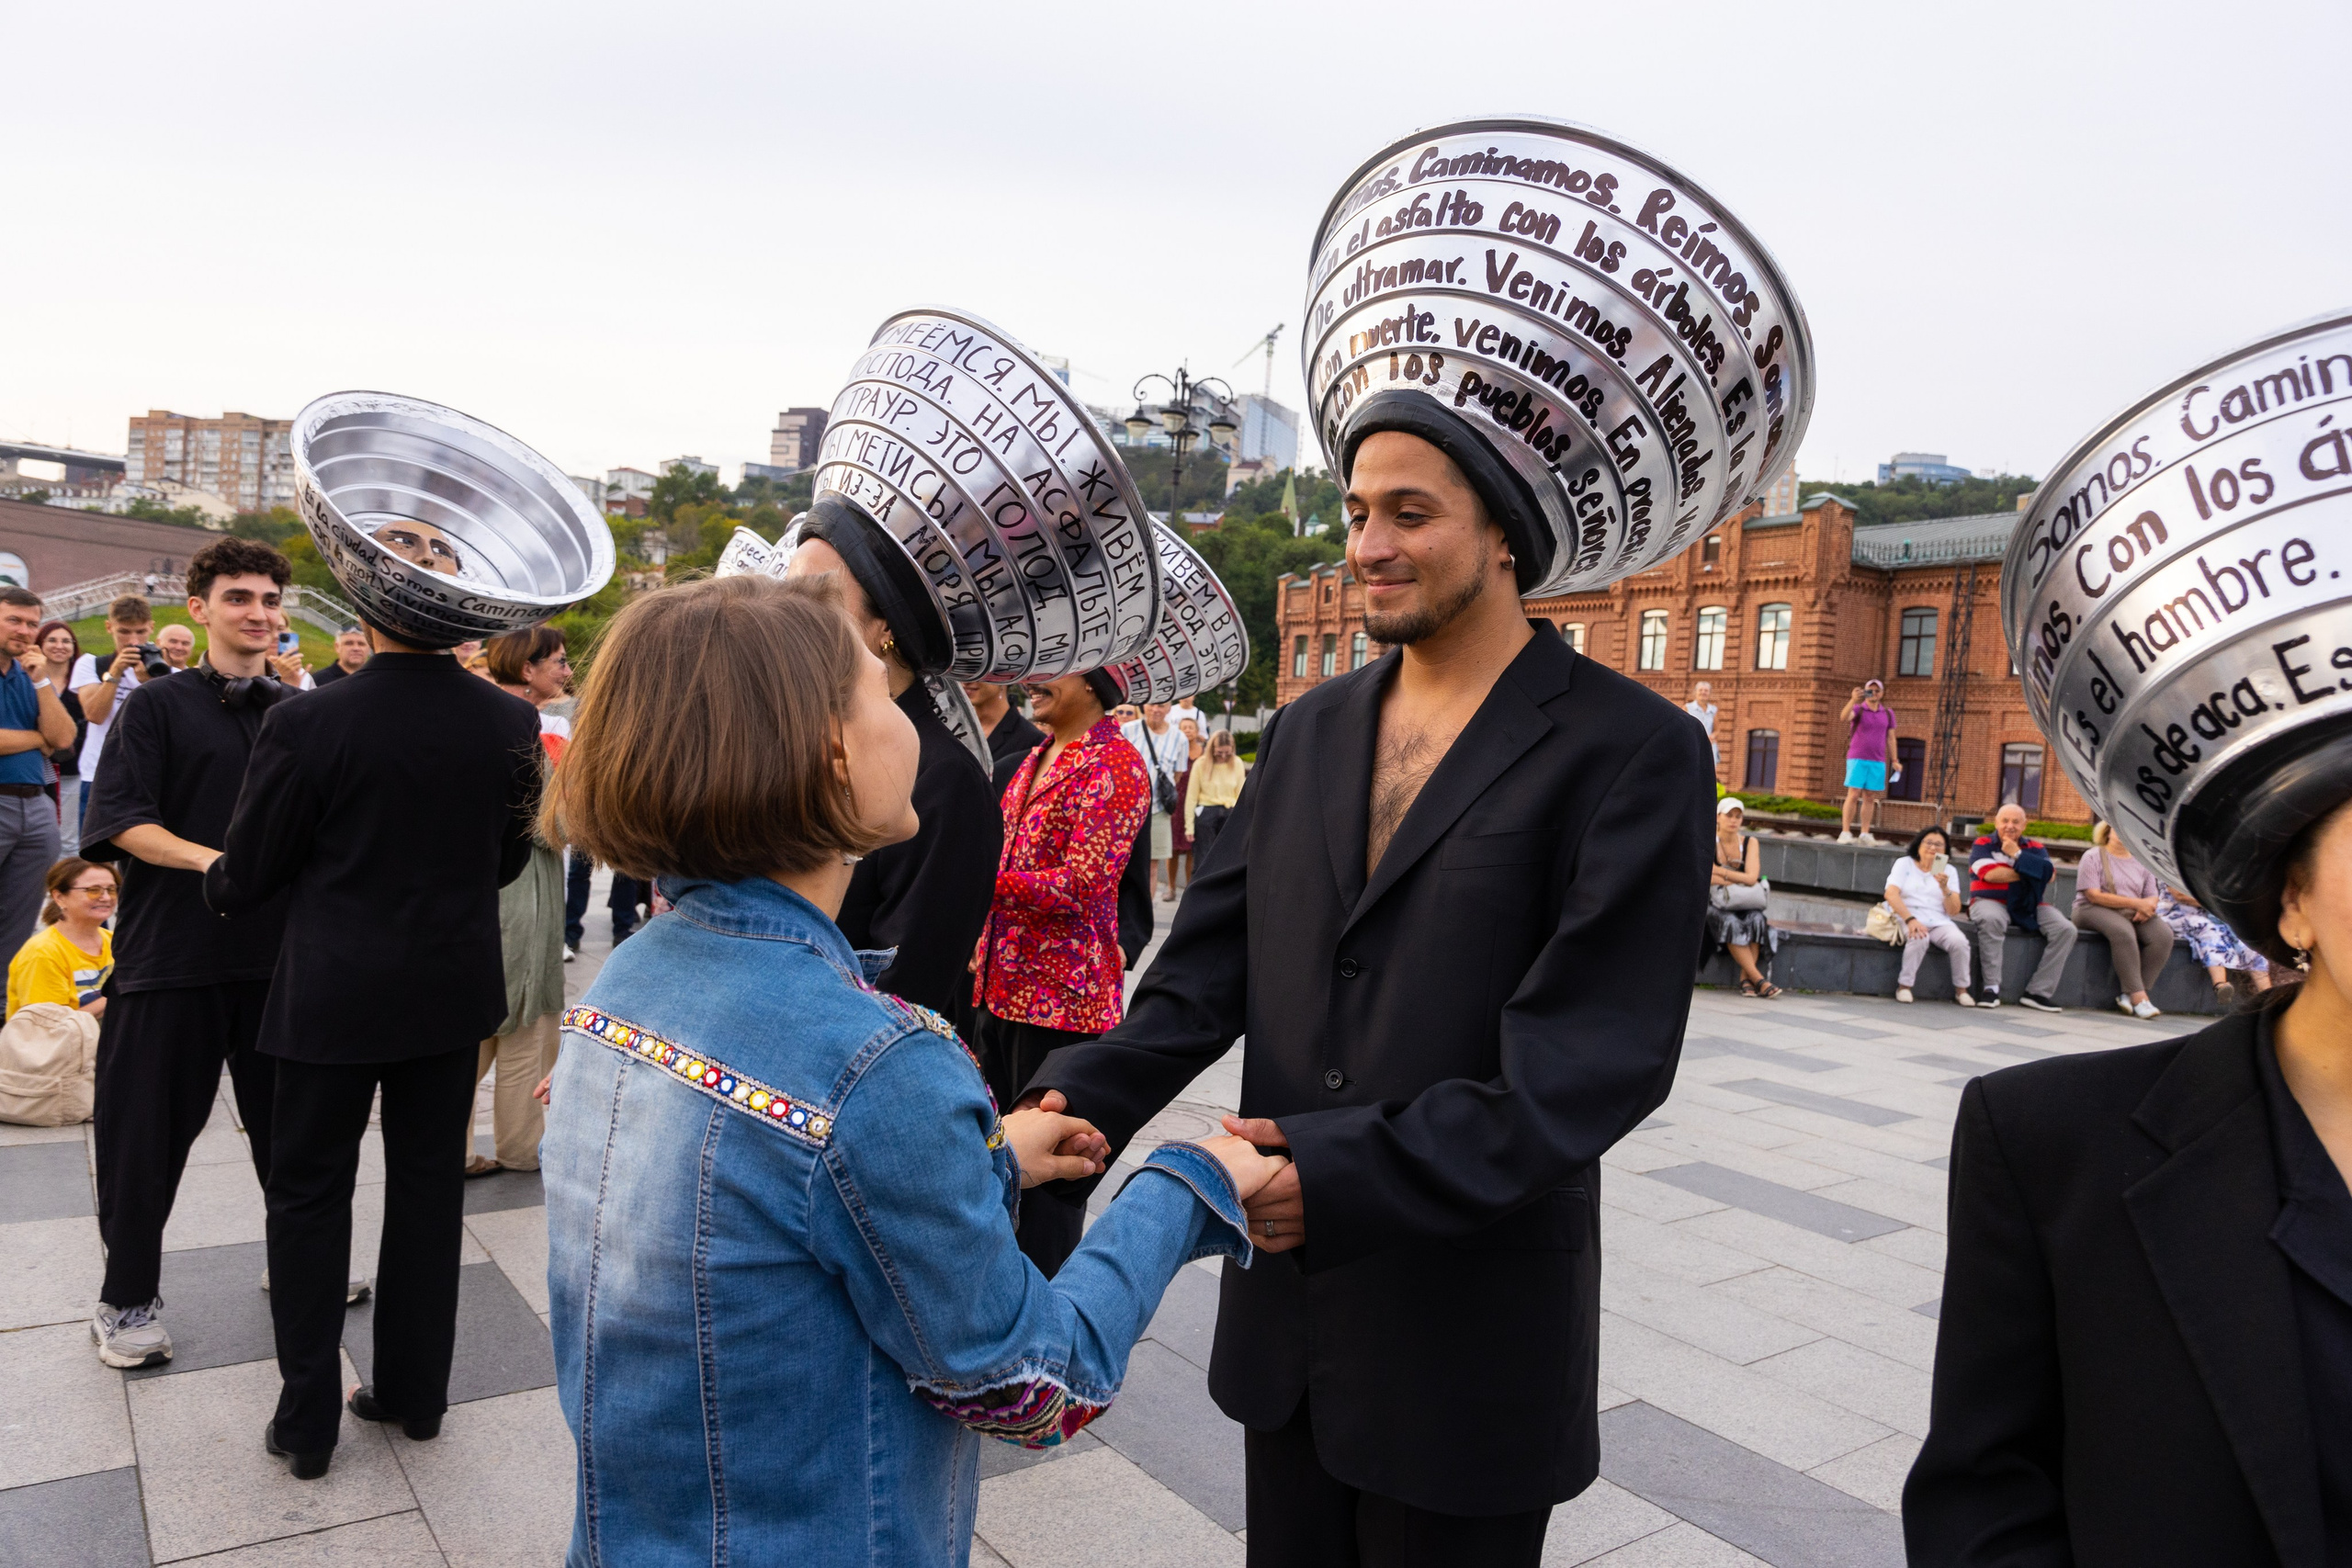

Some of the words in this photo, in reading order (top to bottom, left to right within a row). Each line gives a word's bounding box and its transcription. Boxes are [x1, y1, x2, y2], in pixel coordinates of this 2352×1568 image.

[1315, 299, 1334, 343] De
[1343, 256, 1467, 307] ultramar.
[1486, 248, 1634, 368] Venimos.
[1315, 247, 1340, 292] En
[1347, 219, 1370, 257] el
[1375, 189, 1484, 238] asfalto
[1498, 201, 1562, 245] con
[1573, 220, 1627, 274] los
[1631, 267, 1725, 389] árboles.
[1721, 376, 1754, 437] Es
[1408, 146, 1622, 214] Caminamos.
[1636, 188, 1760, 340] Reímos.
[1318, 349, 1342, 392] Con
[1606, 414, 1647, 475] En
[1334, 364, 1370, 421] Con
[1389, 351, 1445, 386] los
[1453, 370, 1571, 473] pueblos,
[331, 524, 379, 568] ciudad.
[379, 555, 448, 603] Somos
[838, 465, 899, 523] ИЗ-ЗА
[901, 524, 978, 620] МОРЯ.
[844, 428, 964, 540] МЕТИСЫ.
[963, 537, 1014, 608] МЫ.
[851, 352, 953, 405] ОСПОДА.
[972, 403, 1020, 455] НА
[1023, 468, 1112, 643] АСФАЛЬТЕ
[851, 386, 919, 431] ТРАУР.
[926, 420, 982, 475] ЭТО
[980, 480, 1069, 622] ГОЛОД.
[1035, 632, 1070, 667] МЫ
[1010, 382, 1080, 464] МЫ.
[1077, 459, 1146, 614] ЖИВЁМ.
[2027, 434, 2163, 590] Somos.
[2030, 600, 2083, 728] imos.
[2075, 510, 2168, 599] Con
[2184, 457, 2276, 521] los
[2298, 414, 2352, 481] á
[1198, 642, 1220, 679] ЭТО
[1211, 610, 1231, 633] В
[2062, 710, 2100, 773] Es
[2086, 648, 2125, 716] el
[2111, 537, 2341, 674] hambre.
